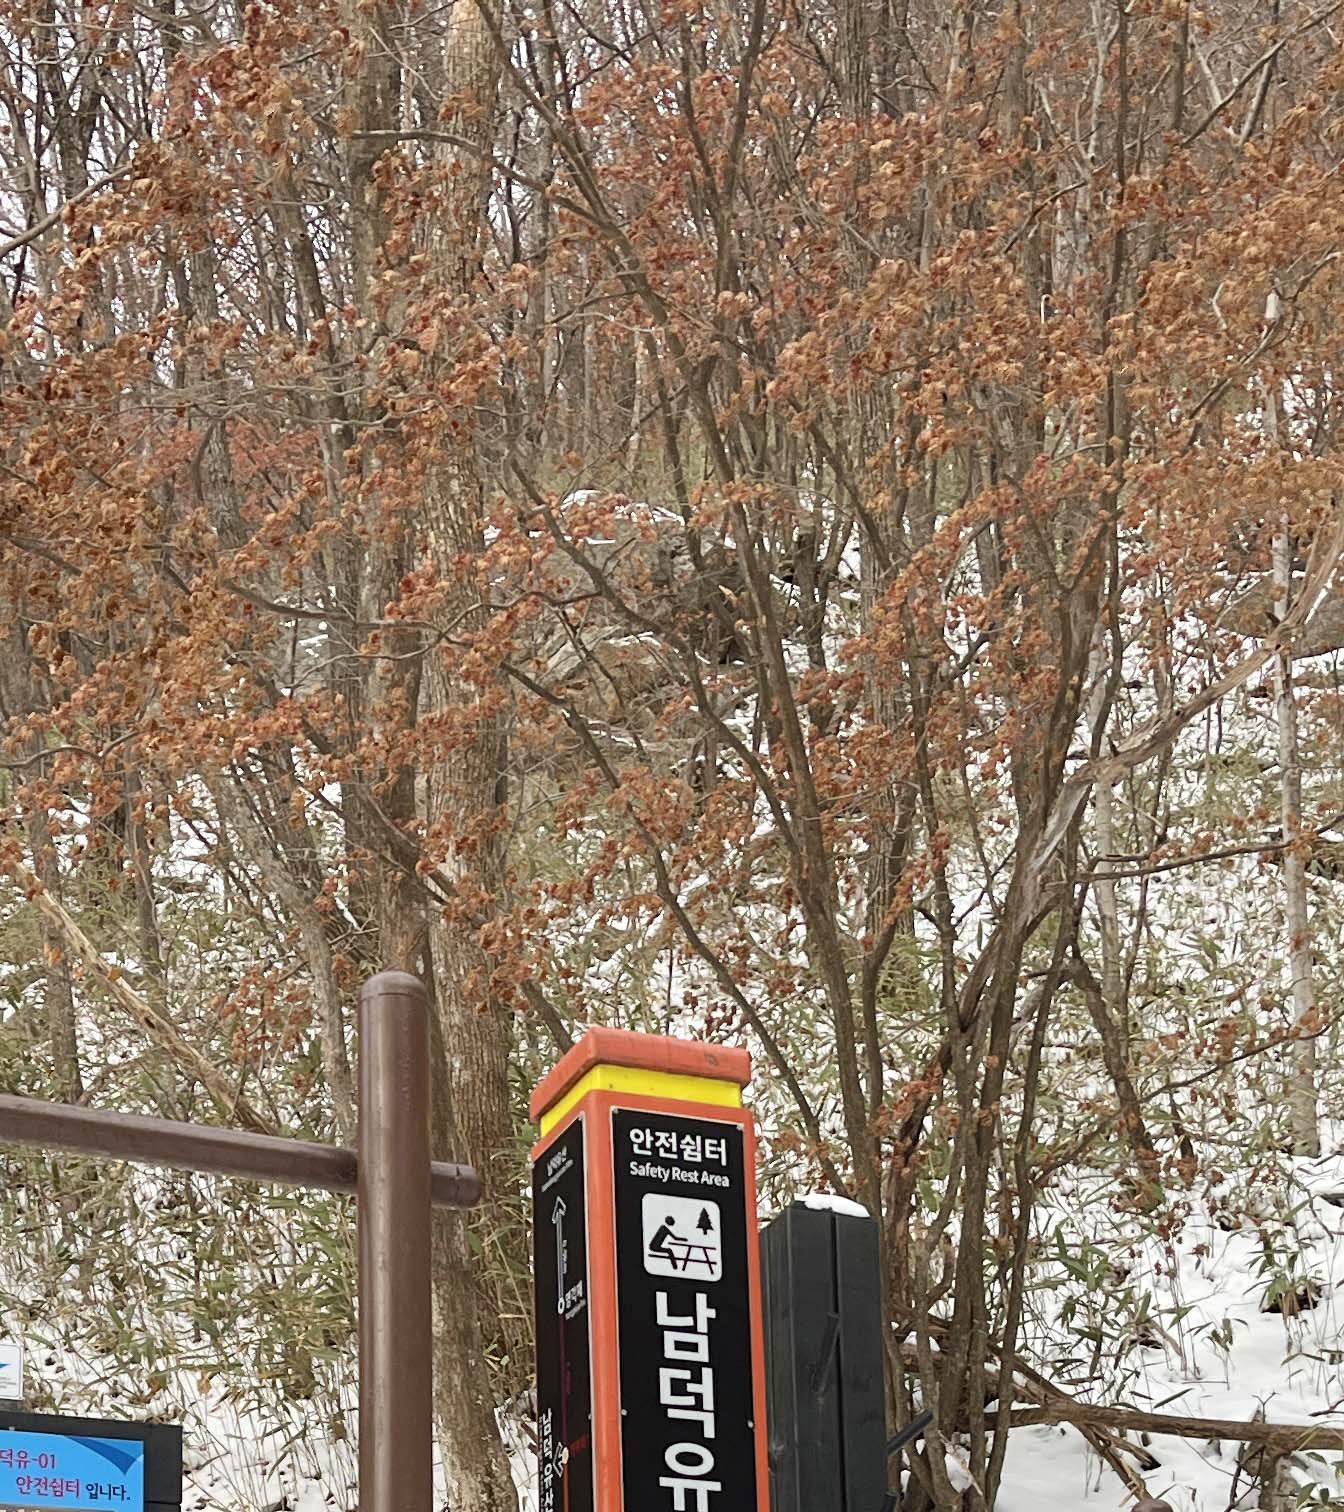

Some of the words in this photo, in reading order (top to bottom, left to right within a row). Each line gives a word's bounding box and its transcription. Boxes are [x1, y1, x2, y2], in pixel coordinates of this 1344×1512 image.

[629, 1127, 727, 1167] 안전쉼터
[629, 1161, 670, 1183] Safety
[671, 1166, 699, 1184] Rest
[700, 1170, 730, 1187] Area
[16, 1475, 80, 1498] 안전쉼터
[85, 1483, 131, 1501] 입니다.
